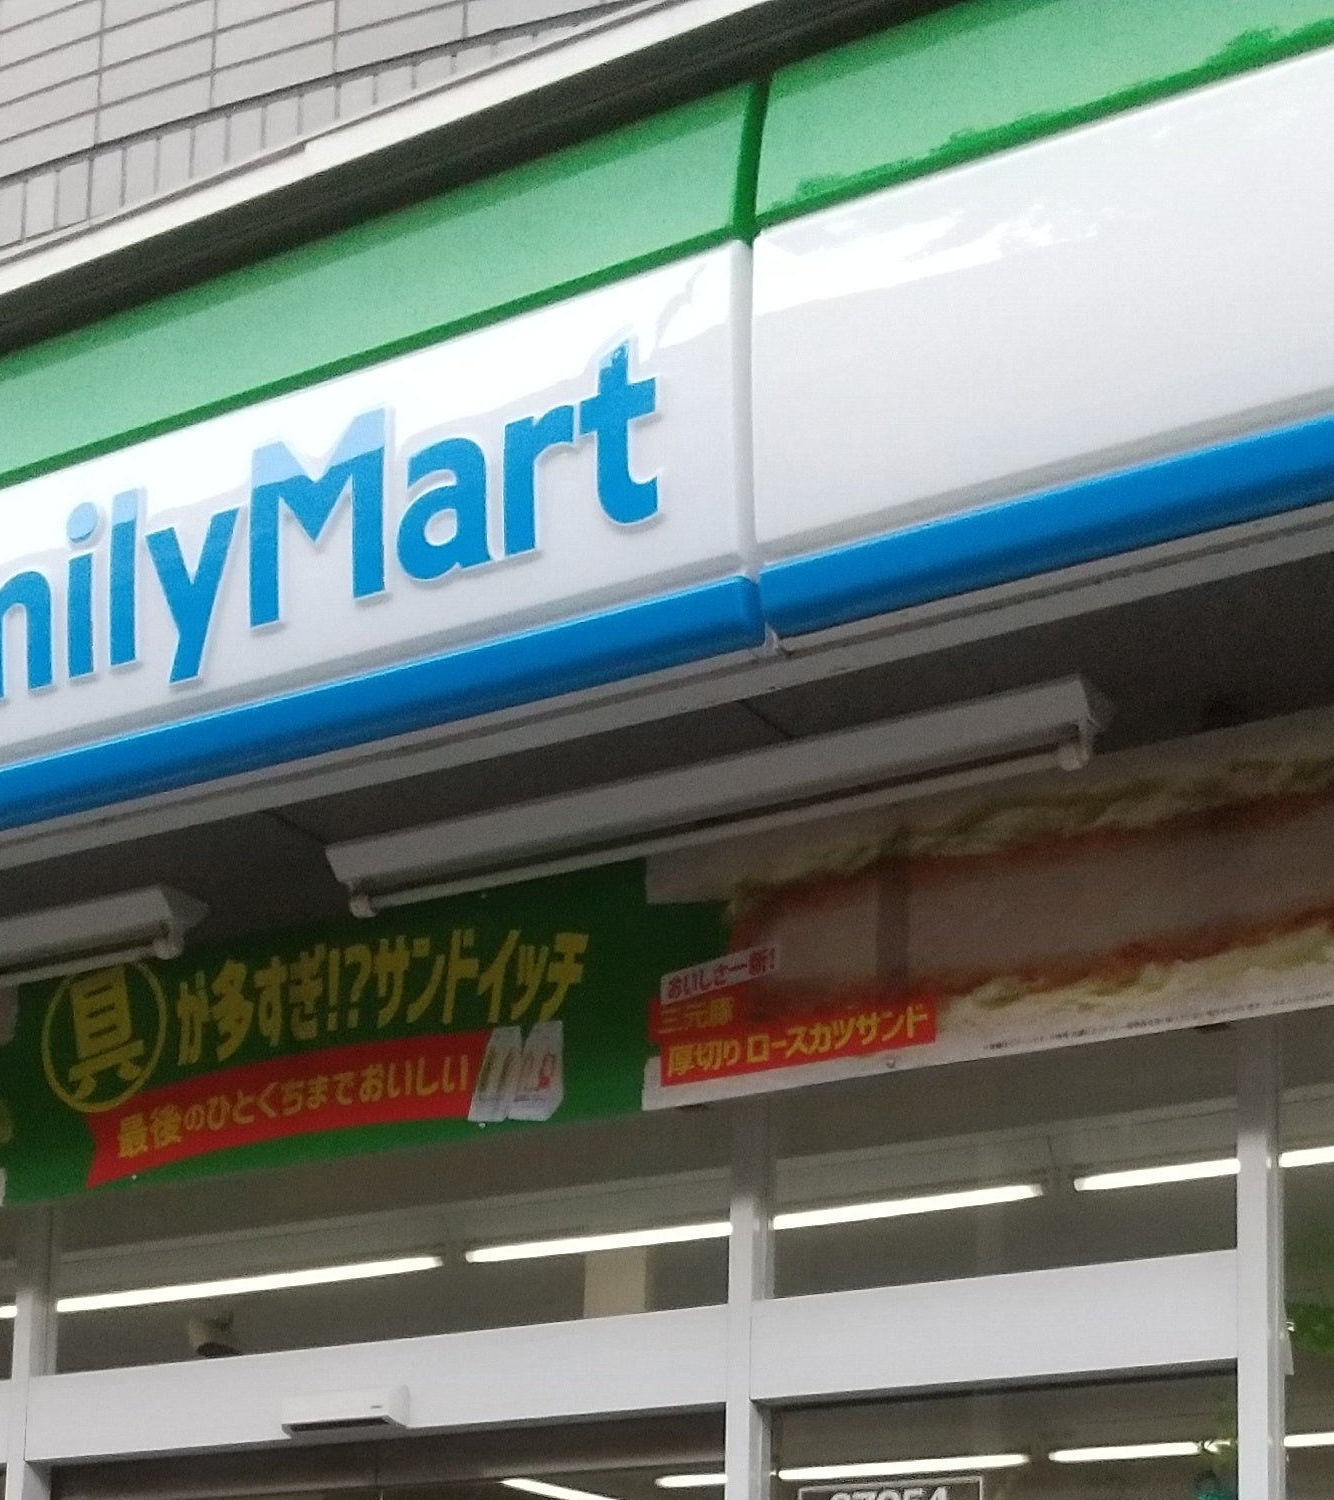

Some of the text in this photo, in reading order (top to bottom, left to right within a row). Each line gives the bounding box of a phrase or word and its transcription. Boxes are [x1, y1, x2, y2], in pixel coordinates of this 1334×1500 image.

[747, 1004, 929, 1062] ロースカツサンド
[118, 1055, 469, 1159] 最後のひとくちまでおいしい
